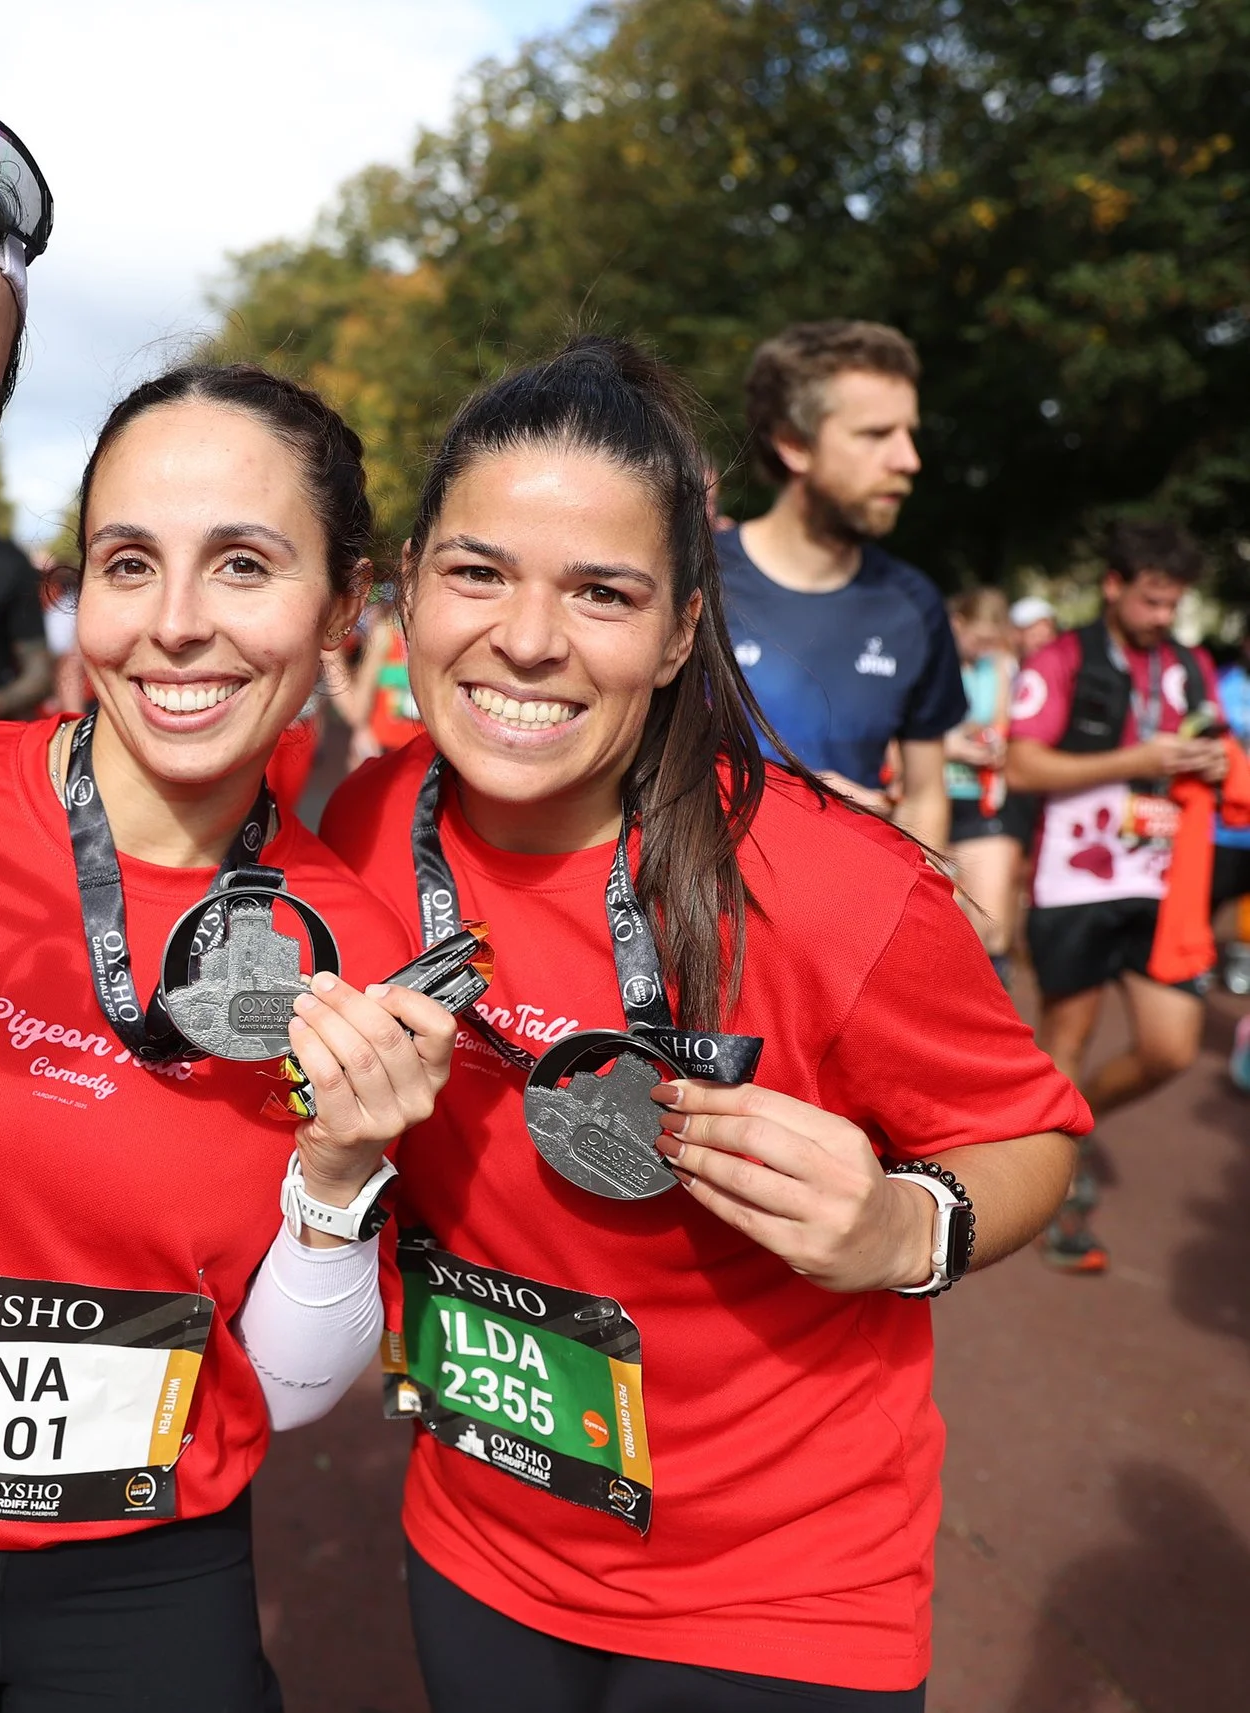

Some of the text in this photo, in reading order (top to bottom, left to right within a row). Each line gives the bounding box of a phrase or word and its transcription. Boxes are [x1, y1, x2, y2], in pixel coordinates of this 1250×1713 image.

[618, 869, 631, 896] HALF
[421, 893, 435, 947] CARDIFF HA
[432, 889, 455, 939] OYS
[623, 896, 644, 934] CARDIFF
[92, 935, 119, 1022] CARDIFF HALF 2025
[103, 930, 139, 1022] OYSHO
[238, 996, 295, 1014] OYSH
[238, 1015, 272, 1023] CARDIFF
[29, 1056, 118, 1100] Comedy
[691, 1063, 715, 1074] 2025
[587, 1129, 656, 1179] OYSHO
[157, 1378, 182, 1434] WHITE PEN
[441, 1361, 555, 1436] 2355
[618, 1382, 636, 1459] PEN GWYRDD
[490, 1433, 552, 1471] OYSHO
[491, 1450, 528, 1472] CARDIFF
[527, 1465, 551, 1481] HALF
[1, 1508, 32, 1516] MARATHON
[30, 1499, 60, 1511] HALF
